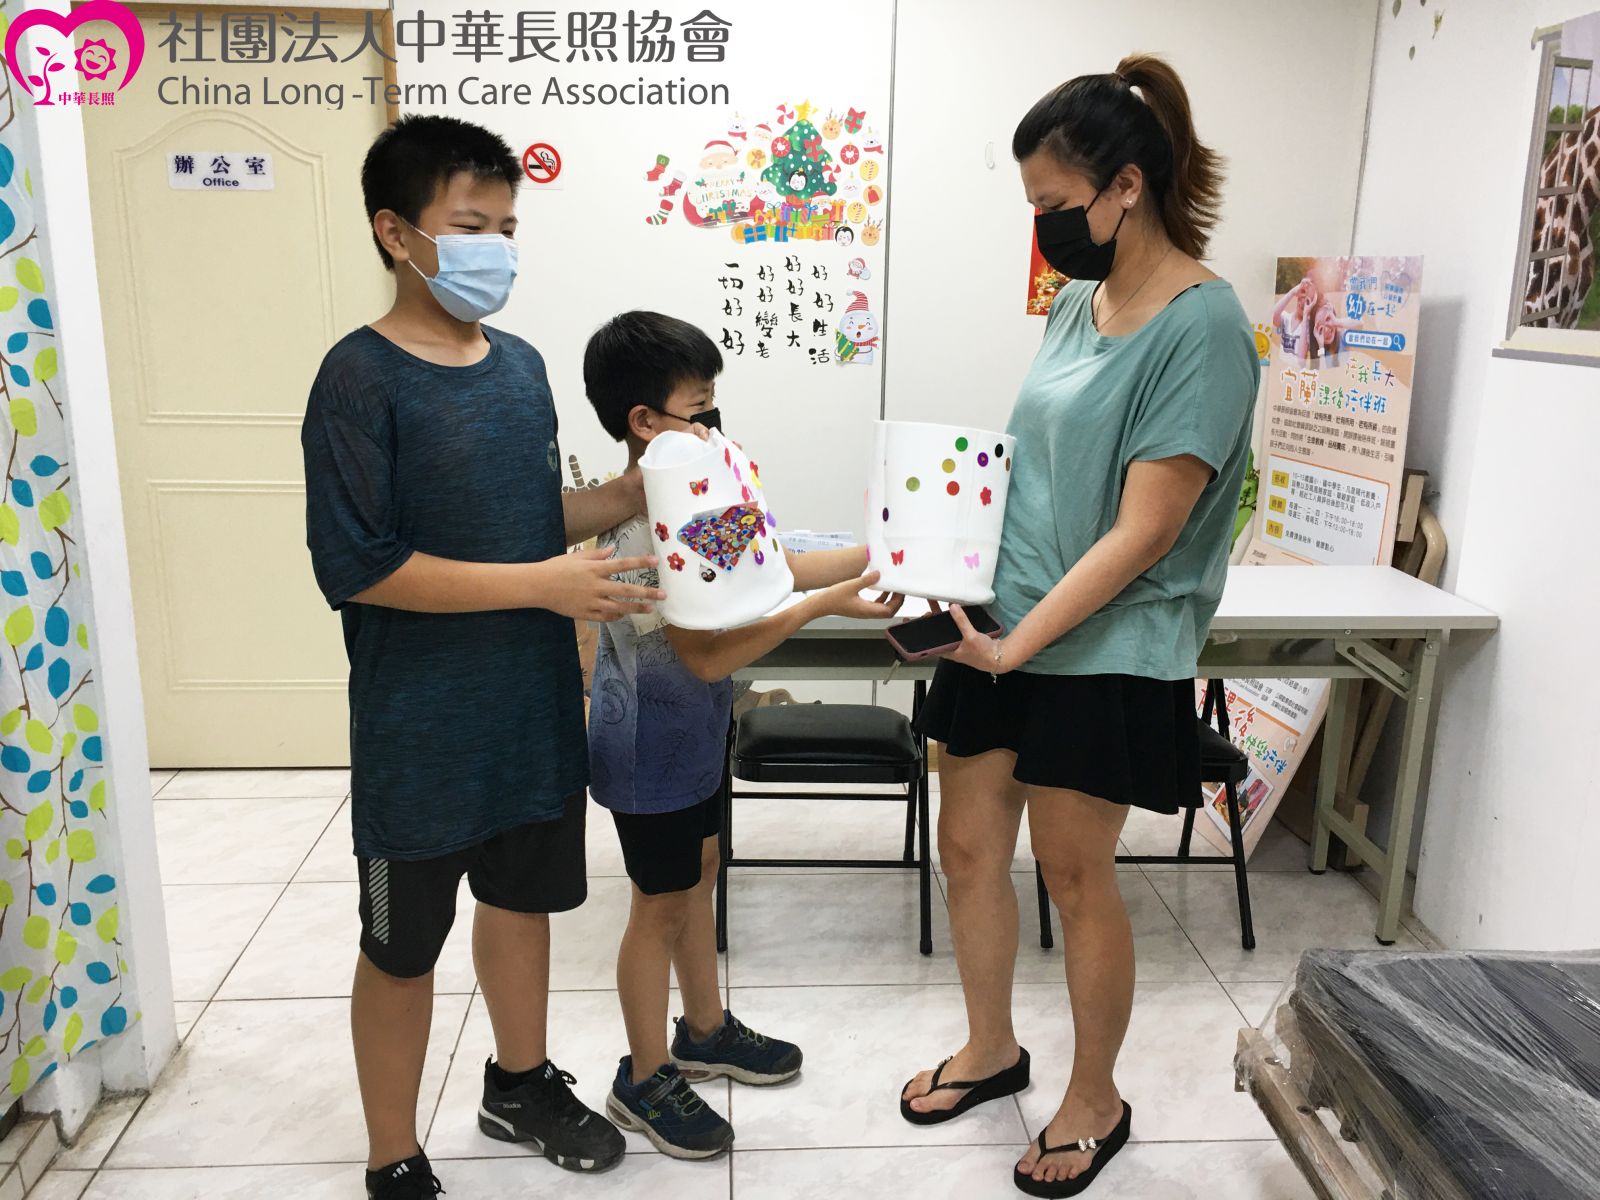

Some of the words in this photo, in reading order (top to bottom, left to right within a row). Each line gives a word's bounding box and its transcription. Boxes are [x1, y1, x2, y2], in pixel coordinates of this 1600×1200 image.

[174, 154, 267, 176] 辦公室
[202, 177, 240, 188] Office
[717, 262, 746, 356] 一切好好
[783, 255, 805, 348] 好好長大
[808, 264, 835, 366] 好好生活
